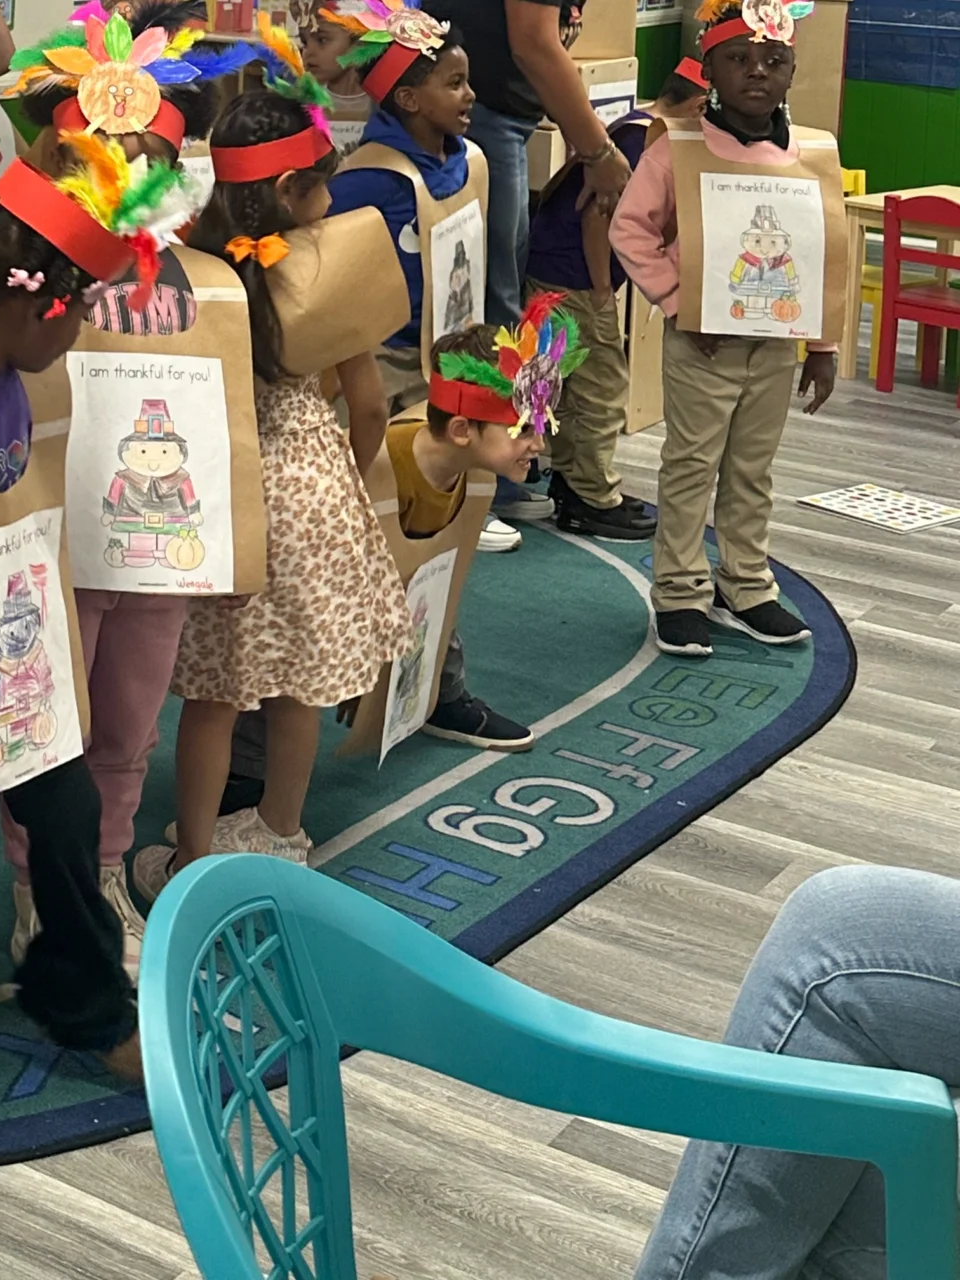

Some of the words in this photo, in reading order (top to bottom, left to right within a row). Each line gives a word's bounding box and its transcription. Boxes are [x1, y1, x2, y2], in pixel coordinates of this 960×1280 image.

[717, 183, 731, 192] am
[735, 180, 772, 193] thankful
[775, 182, 789, 194] for
[89, 367, 110, 379] am
[114, 362, 163, 379] thankful
[168, 364, 186, 381] for
[189, 365, 211, 385] you!
[22, 528, 34, 544] for
